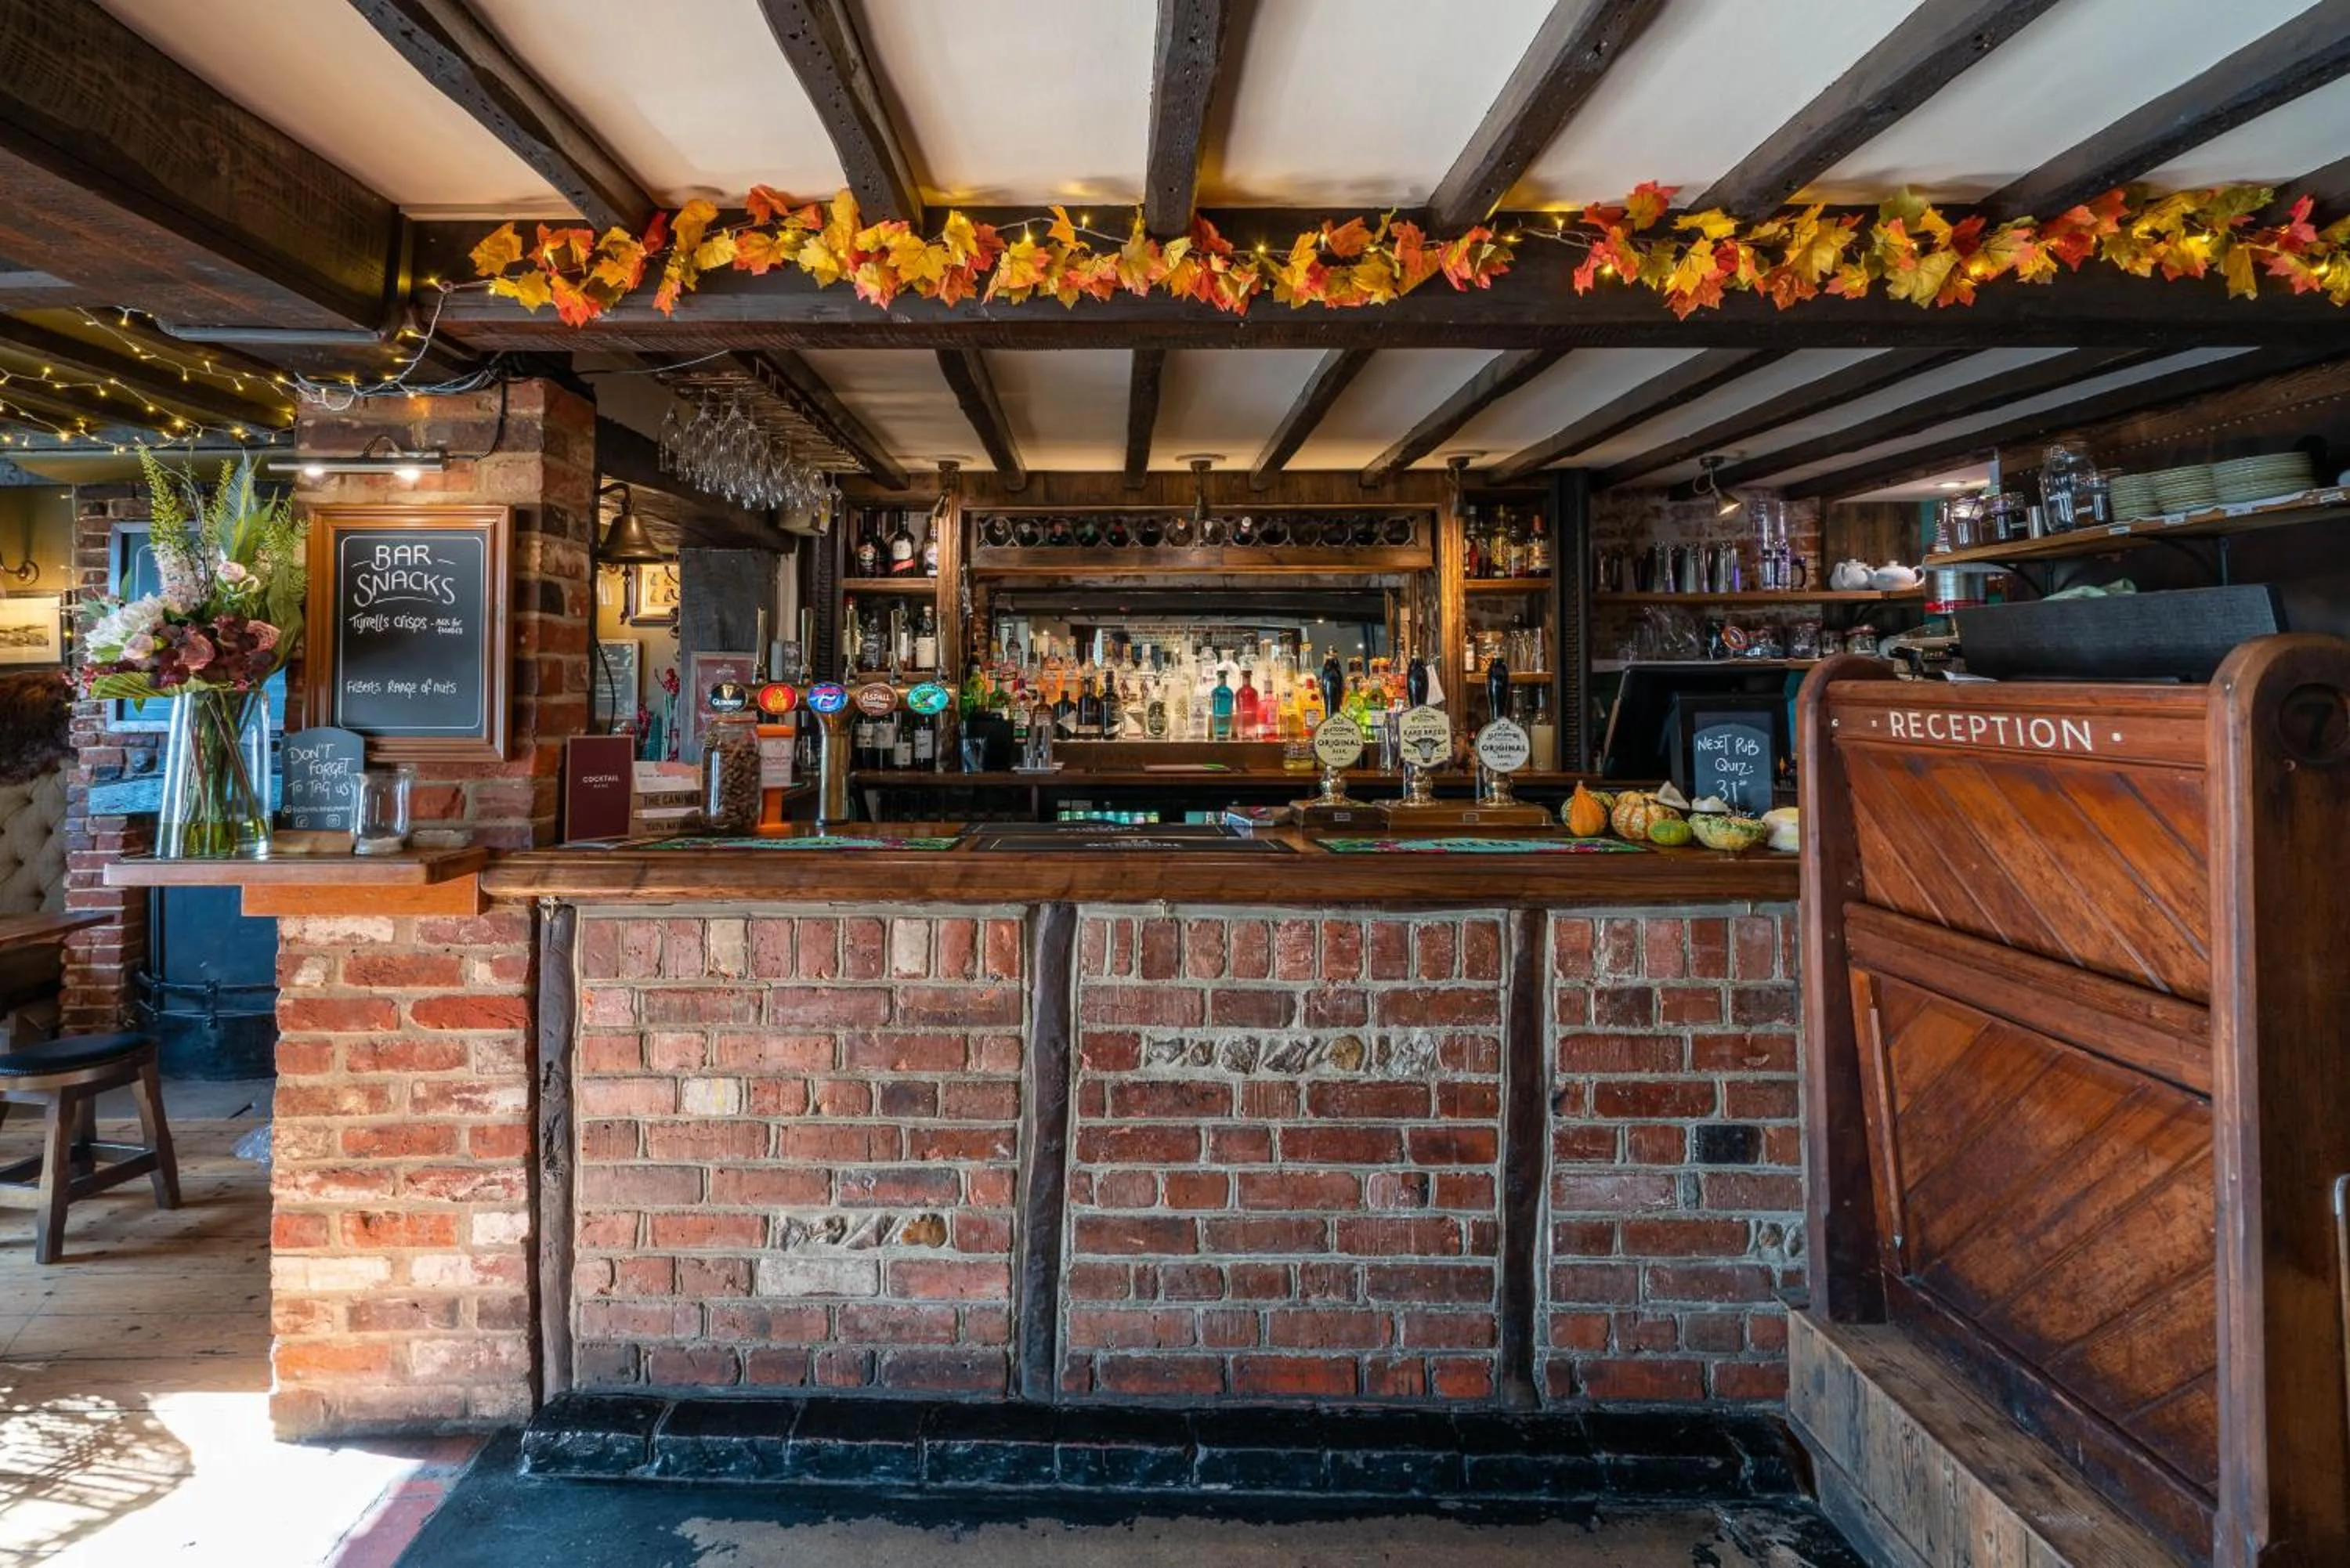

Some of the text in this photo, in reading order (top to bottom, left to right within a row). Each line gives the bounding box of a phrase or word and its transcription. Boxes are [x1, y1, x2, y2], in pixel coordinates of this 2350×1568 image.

[371, 544, 432, 571] BAR
[353, 570, 455, 607] SNACKS
[1889, 710, 2093, 751] RECEPTION
[1697, 735, 1732, 755] NEXT
[582, 775, 619, 783] COCKTAIL
